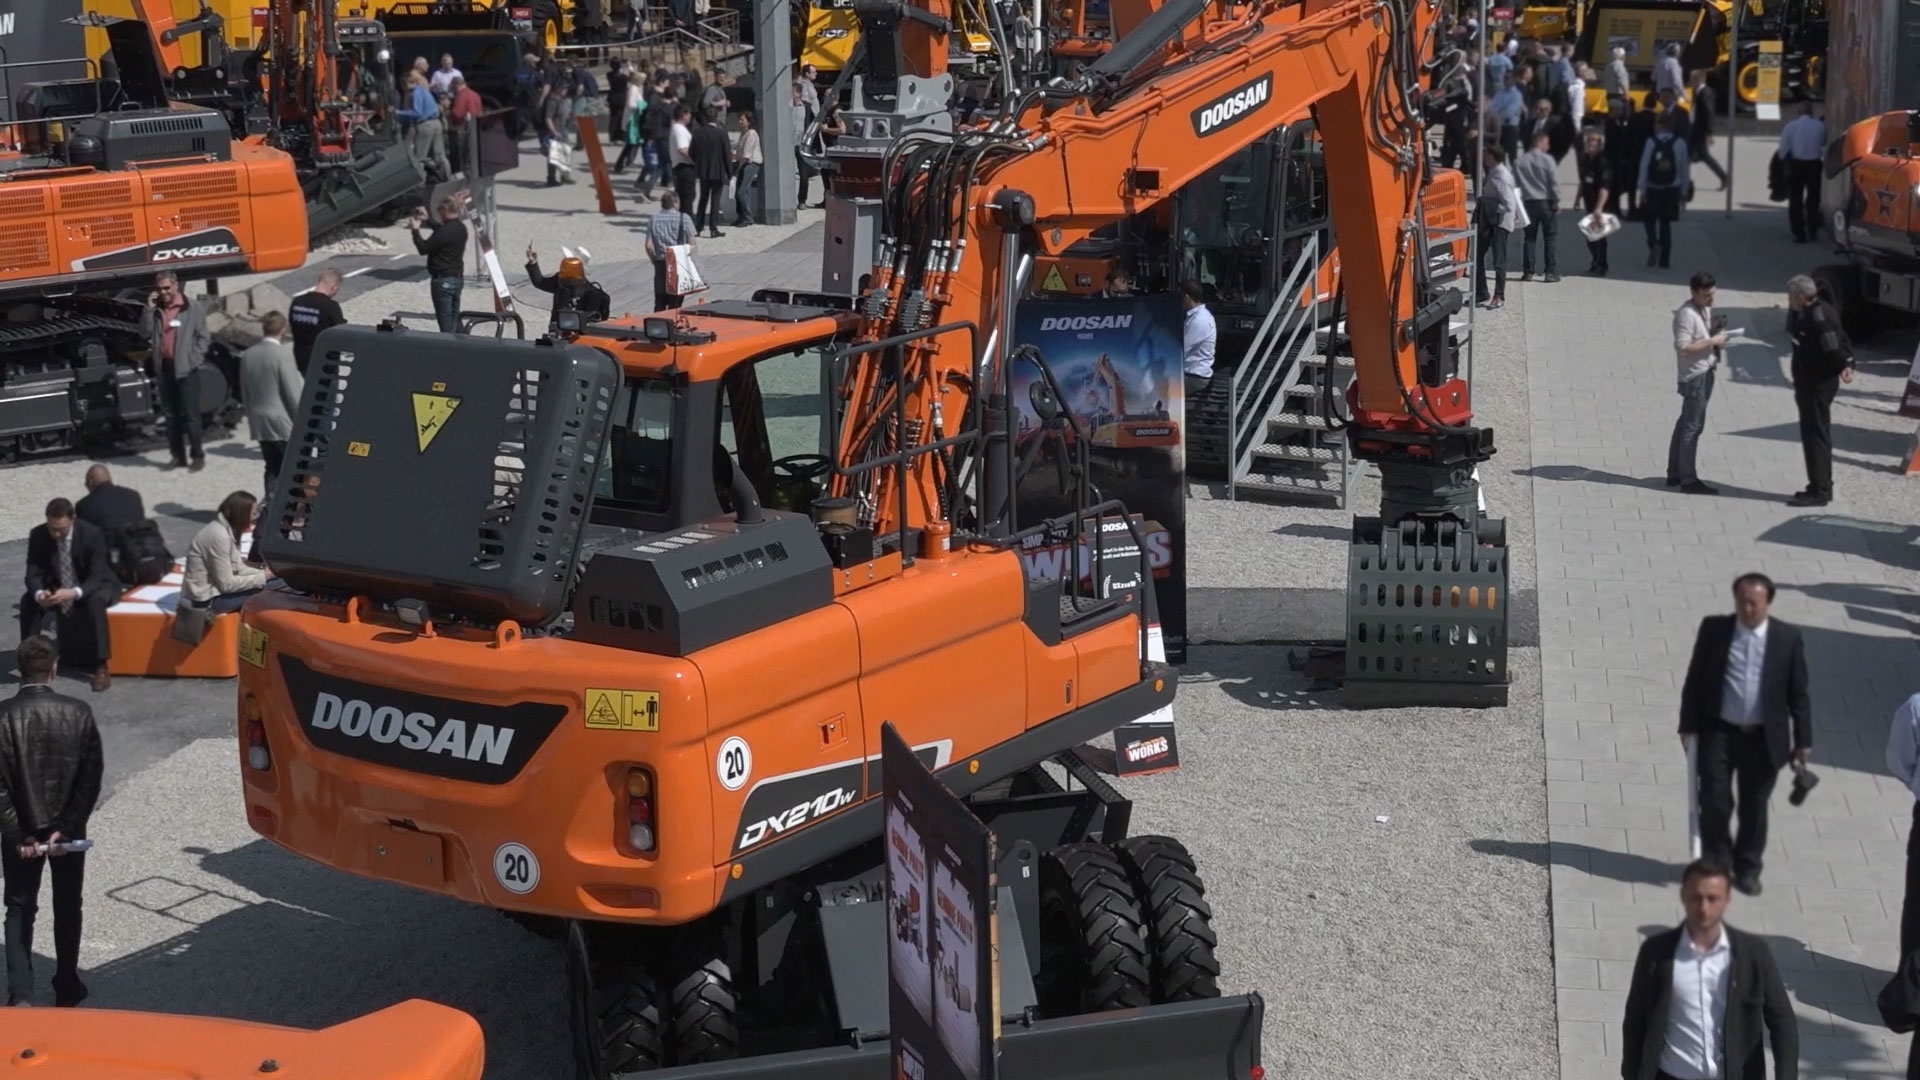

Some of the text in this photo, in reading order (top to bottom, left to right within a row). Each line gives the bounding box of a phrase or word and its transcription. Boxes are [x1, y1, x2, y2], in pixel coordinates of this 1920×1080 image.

[1199, 79, 1268, 133] DOOSAN
[1040, 314, 1133, 331] DOOSAN
[311, 691, 515, 766] DOOSAN
[725, 747, 745, 781] 20
[1128, 739, 1169, 762] WORKS
[503, 852, 530, 883] 20
